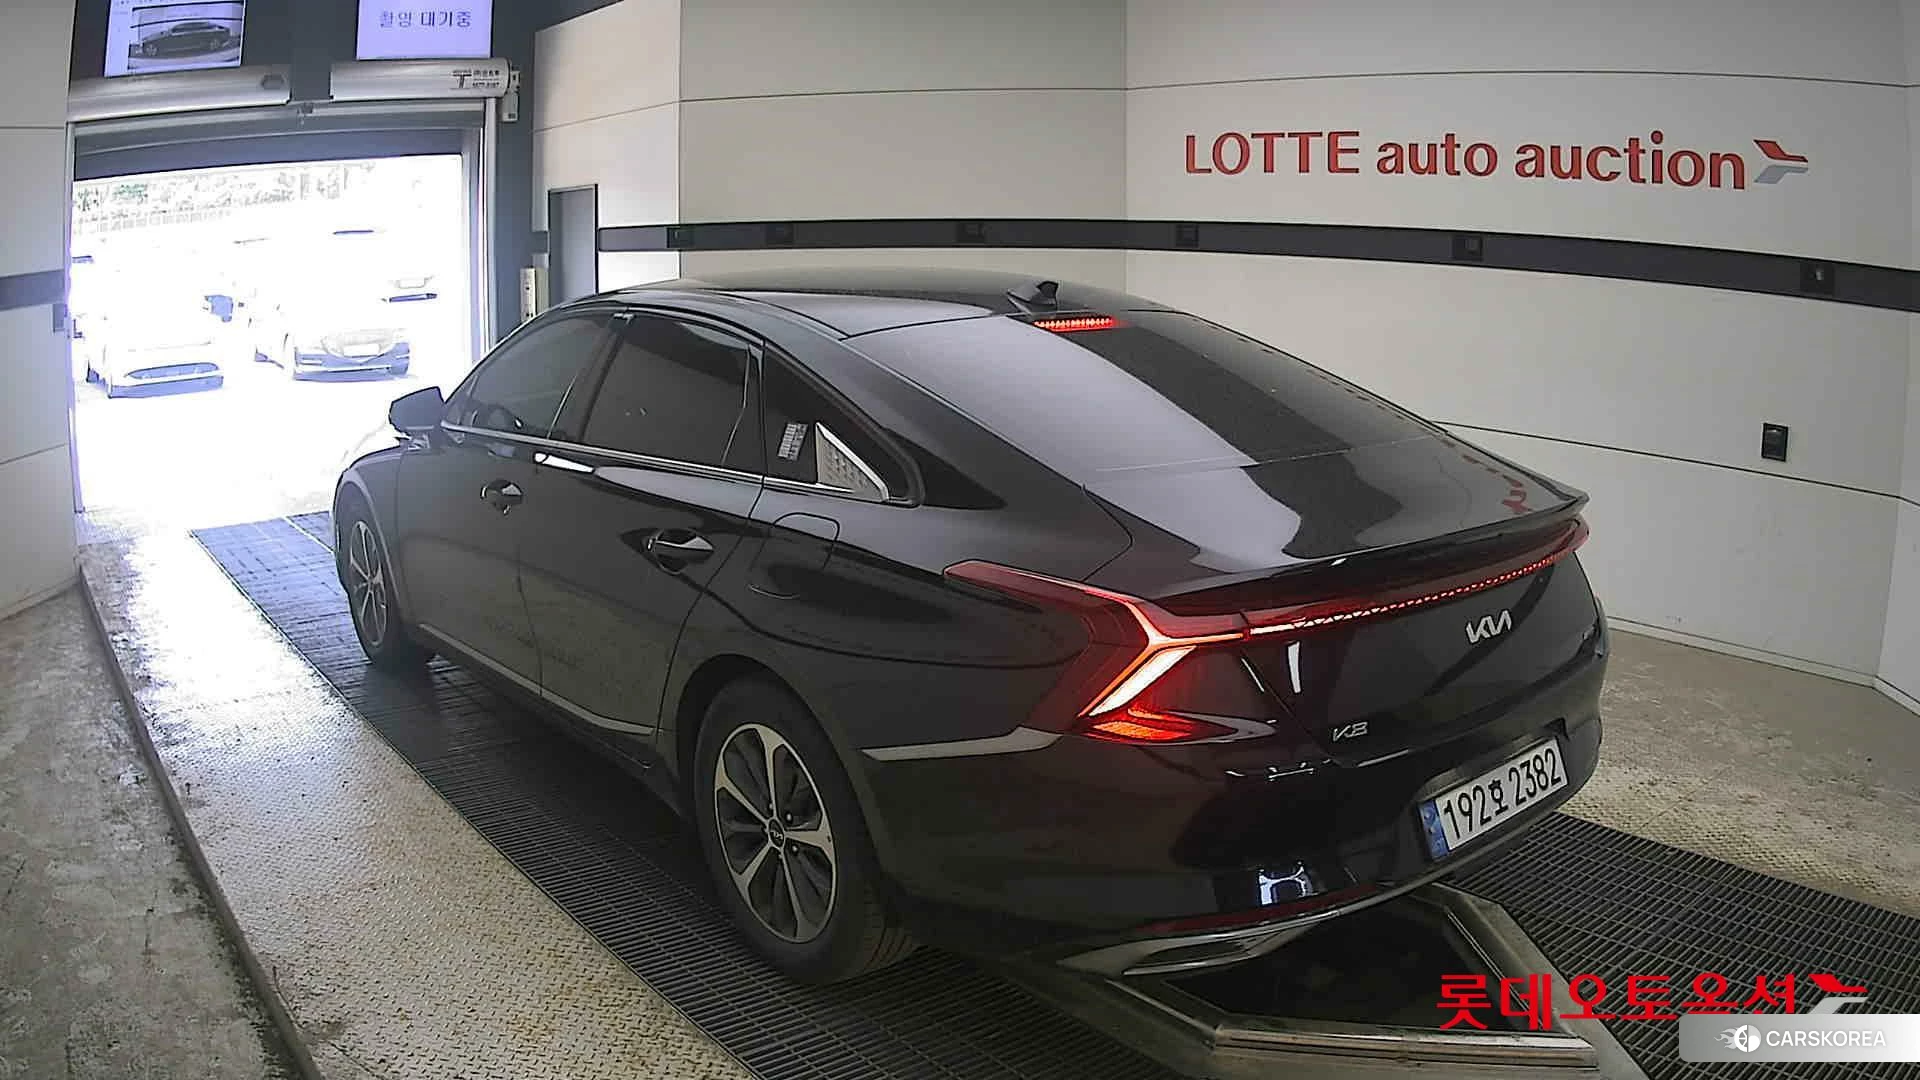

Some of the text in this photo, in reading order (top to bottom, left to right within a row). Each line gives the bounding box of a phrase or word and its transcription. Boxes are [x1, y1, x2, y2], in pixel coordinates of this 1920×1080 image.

[421, 10, 472, 28] 대기중
[1185, 131, 1746, 190] LOTTE auto auction
[1465, 610, 1512, 643] KIA
[1333, 721, 1367, 741] K8
[1444, 748, 1561, 839] 192호 2382
